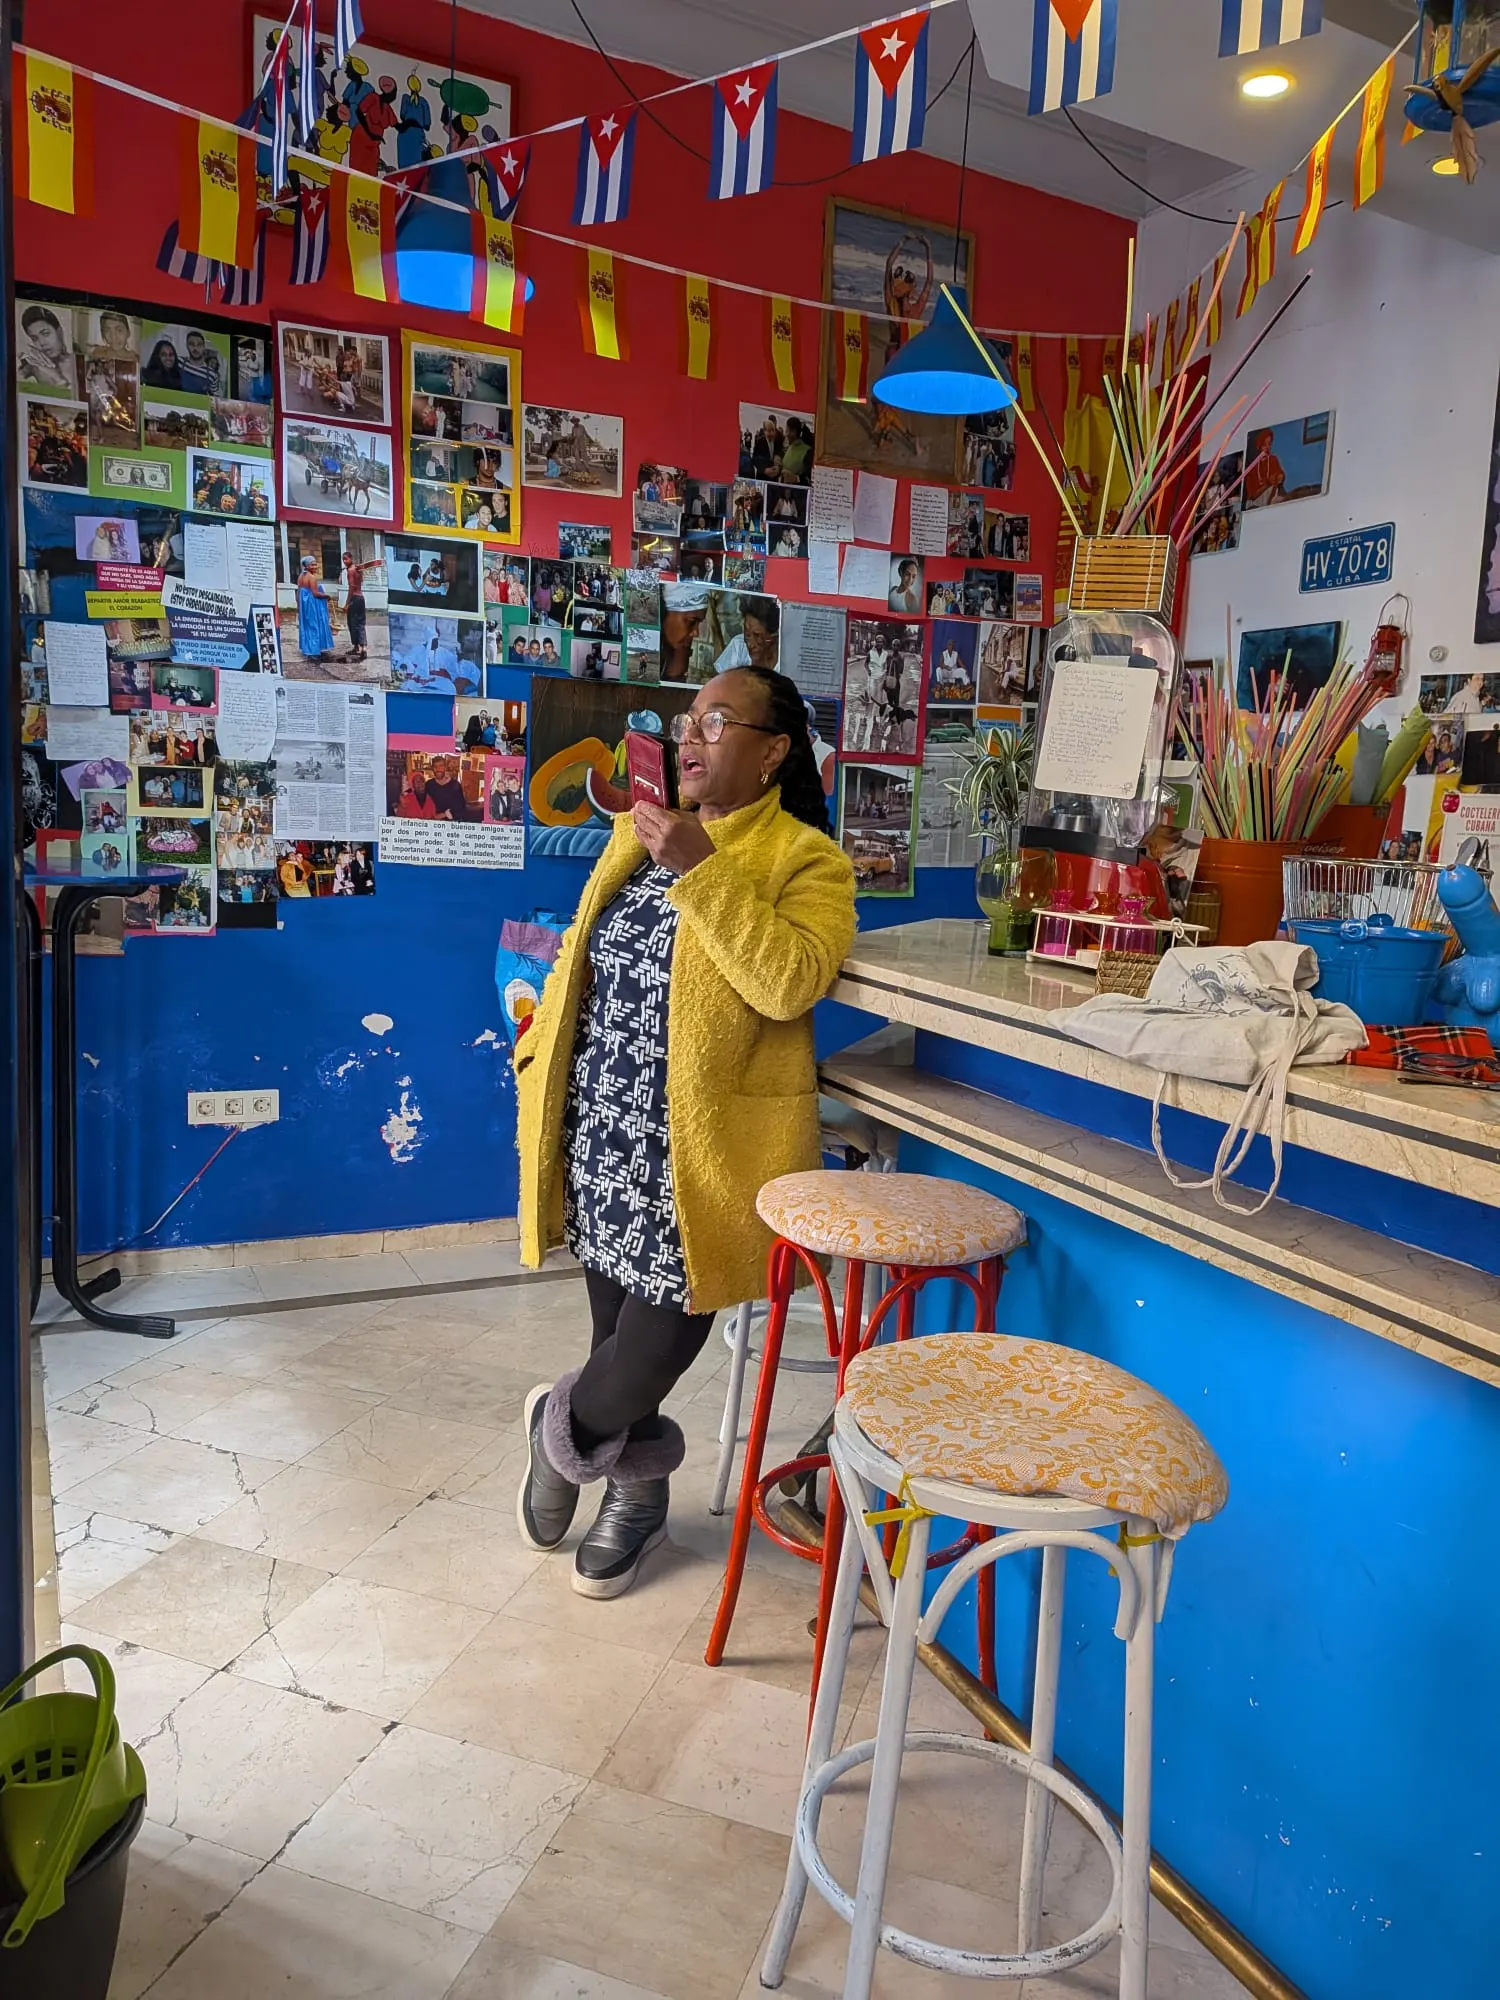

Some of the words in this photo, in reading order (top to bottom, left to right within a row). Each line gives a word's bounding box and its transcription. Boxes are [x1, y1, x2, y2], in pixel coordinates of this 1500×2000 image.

[1329, 536, 1362, 548] ESTATAL
[1326, 574, 1360, 587] CUBA
[174, 582, 183, 593] NO
[170, 593, 185, 606] ESTOY
[211, 618, 244, 626] IGNORANCIA
[224, 626, 246, 634] SUICIDIO
[218, 644, 235, 652] MUJER
[381, 818, 395, 826] Una
[400, 820, 428, 828] infancia
[451, 822, 475, 830] buenos
[481, 826, 504, 834] amigos
[510, 826, 522, 834] vale
[1466, 820, 1496, 832] CUBANA
[465, 833, 485, 841] campo
[394, 837, 420, 845] siempre
[424, 838, 444, 846] poder.
[474, 842, 495, 850] padres
[392, 845, 430, 854] importancia
[462, 850, 496, 858] amistades,
[381, 853, 420, 862] favorecerlas
[426, 856, 456, 864] encauzar
[457, 857, 476, 865] malos
[476, 858, 520, 867] contratiempos.
